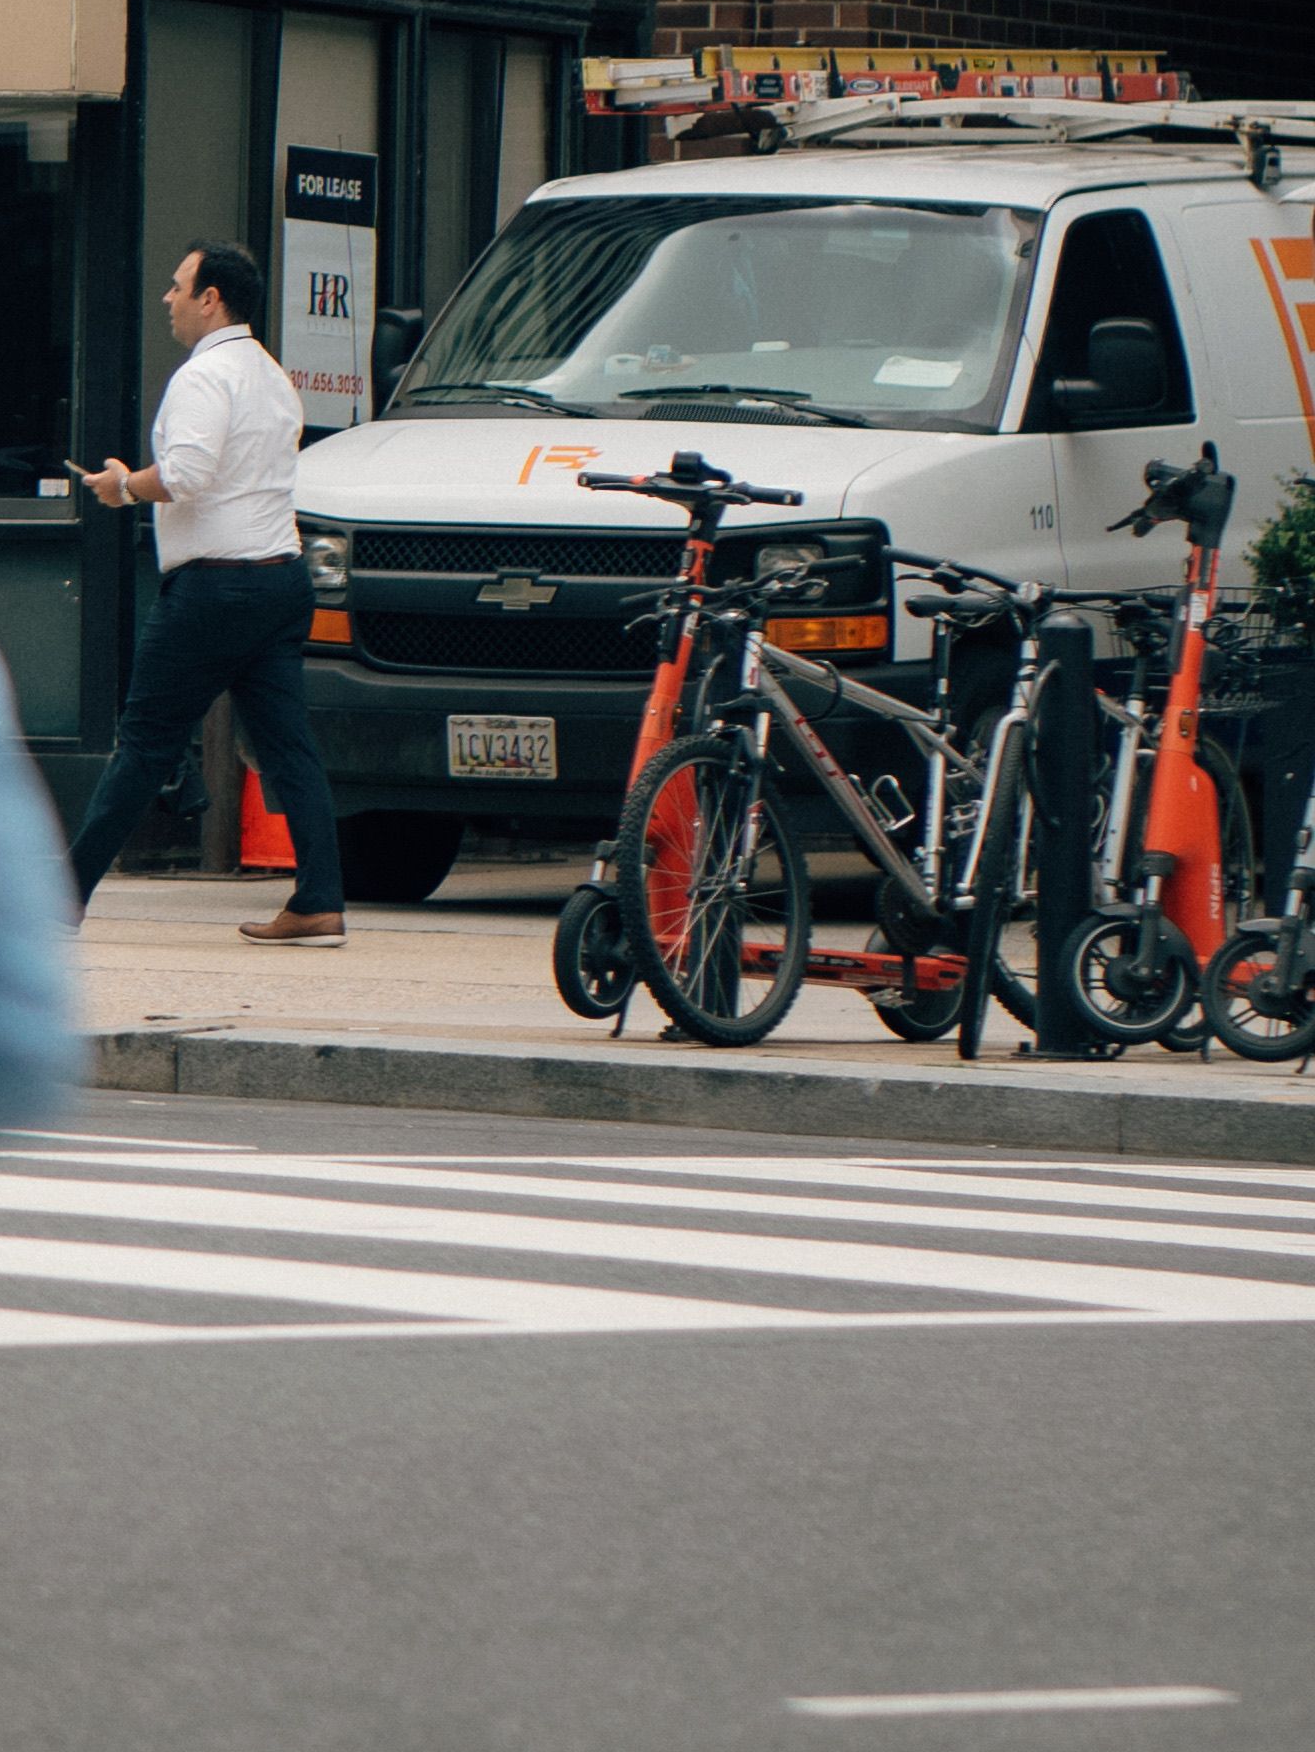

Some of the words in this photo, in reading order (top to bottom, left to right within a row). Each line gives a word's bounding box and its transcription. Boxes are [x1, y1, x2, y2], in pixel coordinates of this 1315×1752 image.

[299, 174, 324, 195] FOR
[326, 177, 362, 200] LEASE
[290, 369, 364, 395] 301.656.3030
[1030, 504, 1054, 530] 110
[457, 733, 549, 766] 1CV3432
